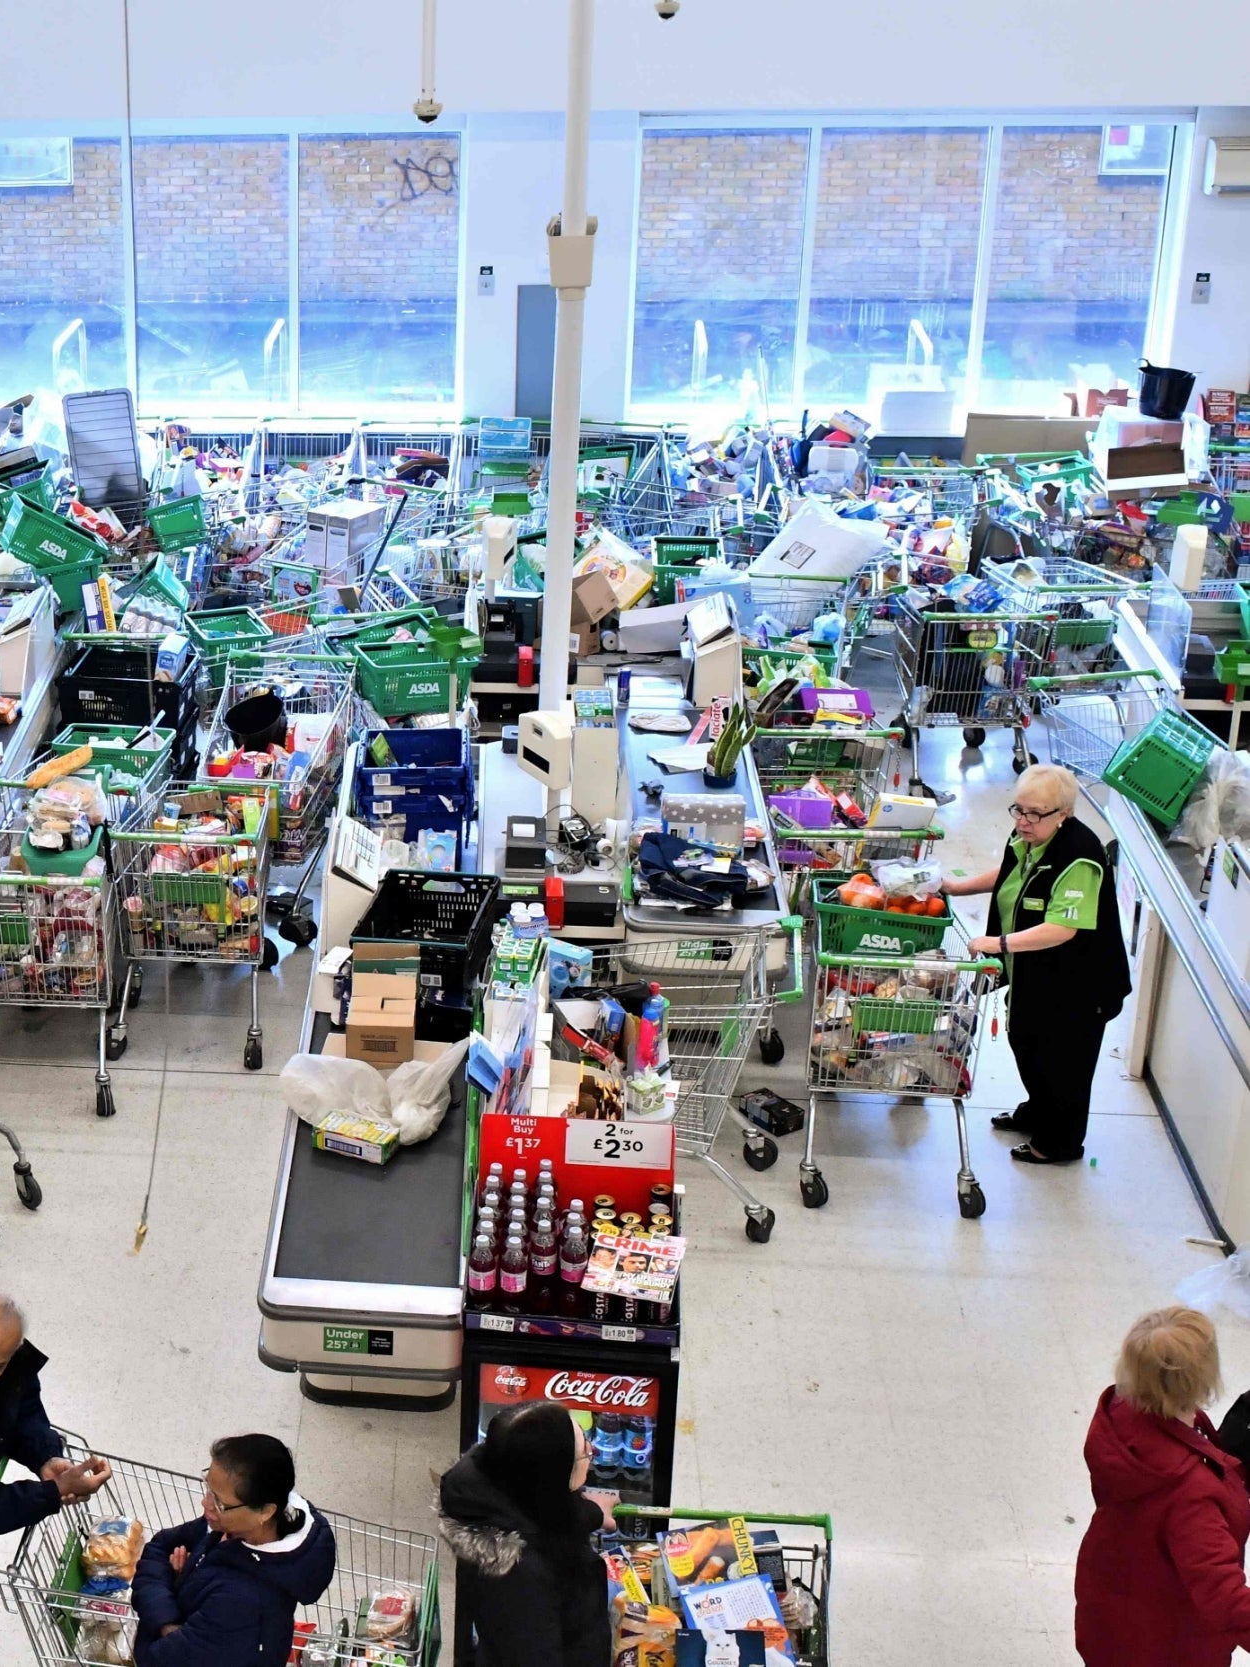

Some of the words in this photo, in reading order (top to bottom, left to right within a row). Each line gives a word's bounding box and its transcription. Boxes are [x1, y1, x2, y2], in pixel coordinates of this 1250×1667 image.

[39, 539, 67, 560] ASDA
[408, 682, 440, 695] ASDA
[680, 940, 709, 949] Under
[859, 933, 902, 951] ASDA
[510, 1117, 537, 1127] Multi
[513, 1125, 534, 1135] Buy
[604, 1123, 617, 1137] 2
[619, 1127, 634, 1136] for
[597, 1234, 678, 1257] CRIME
[326, 1328, 364, 1340] Under
[326, 1339, 348, 1349] 25?
[494, 1375, 527, 1388] Coca-Cola
[577, 1371, 596, 1379] Enjoy
[544, 1371, 653, 1407] Coca-Cola
[732, 1518, 756, 1573] CHUNKY
[694, 1595, 723, 1610] WORD
